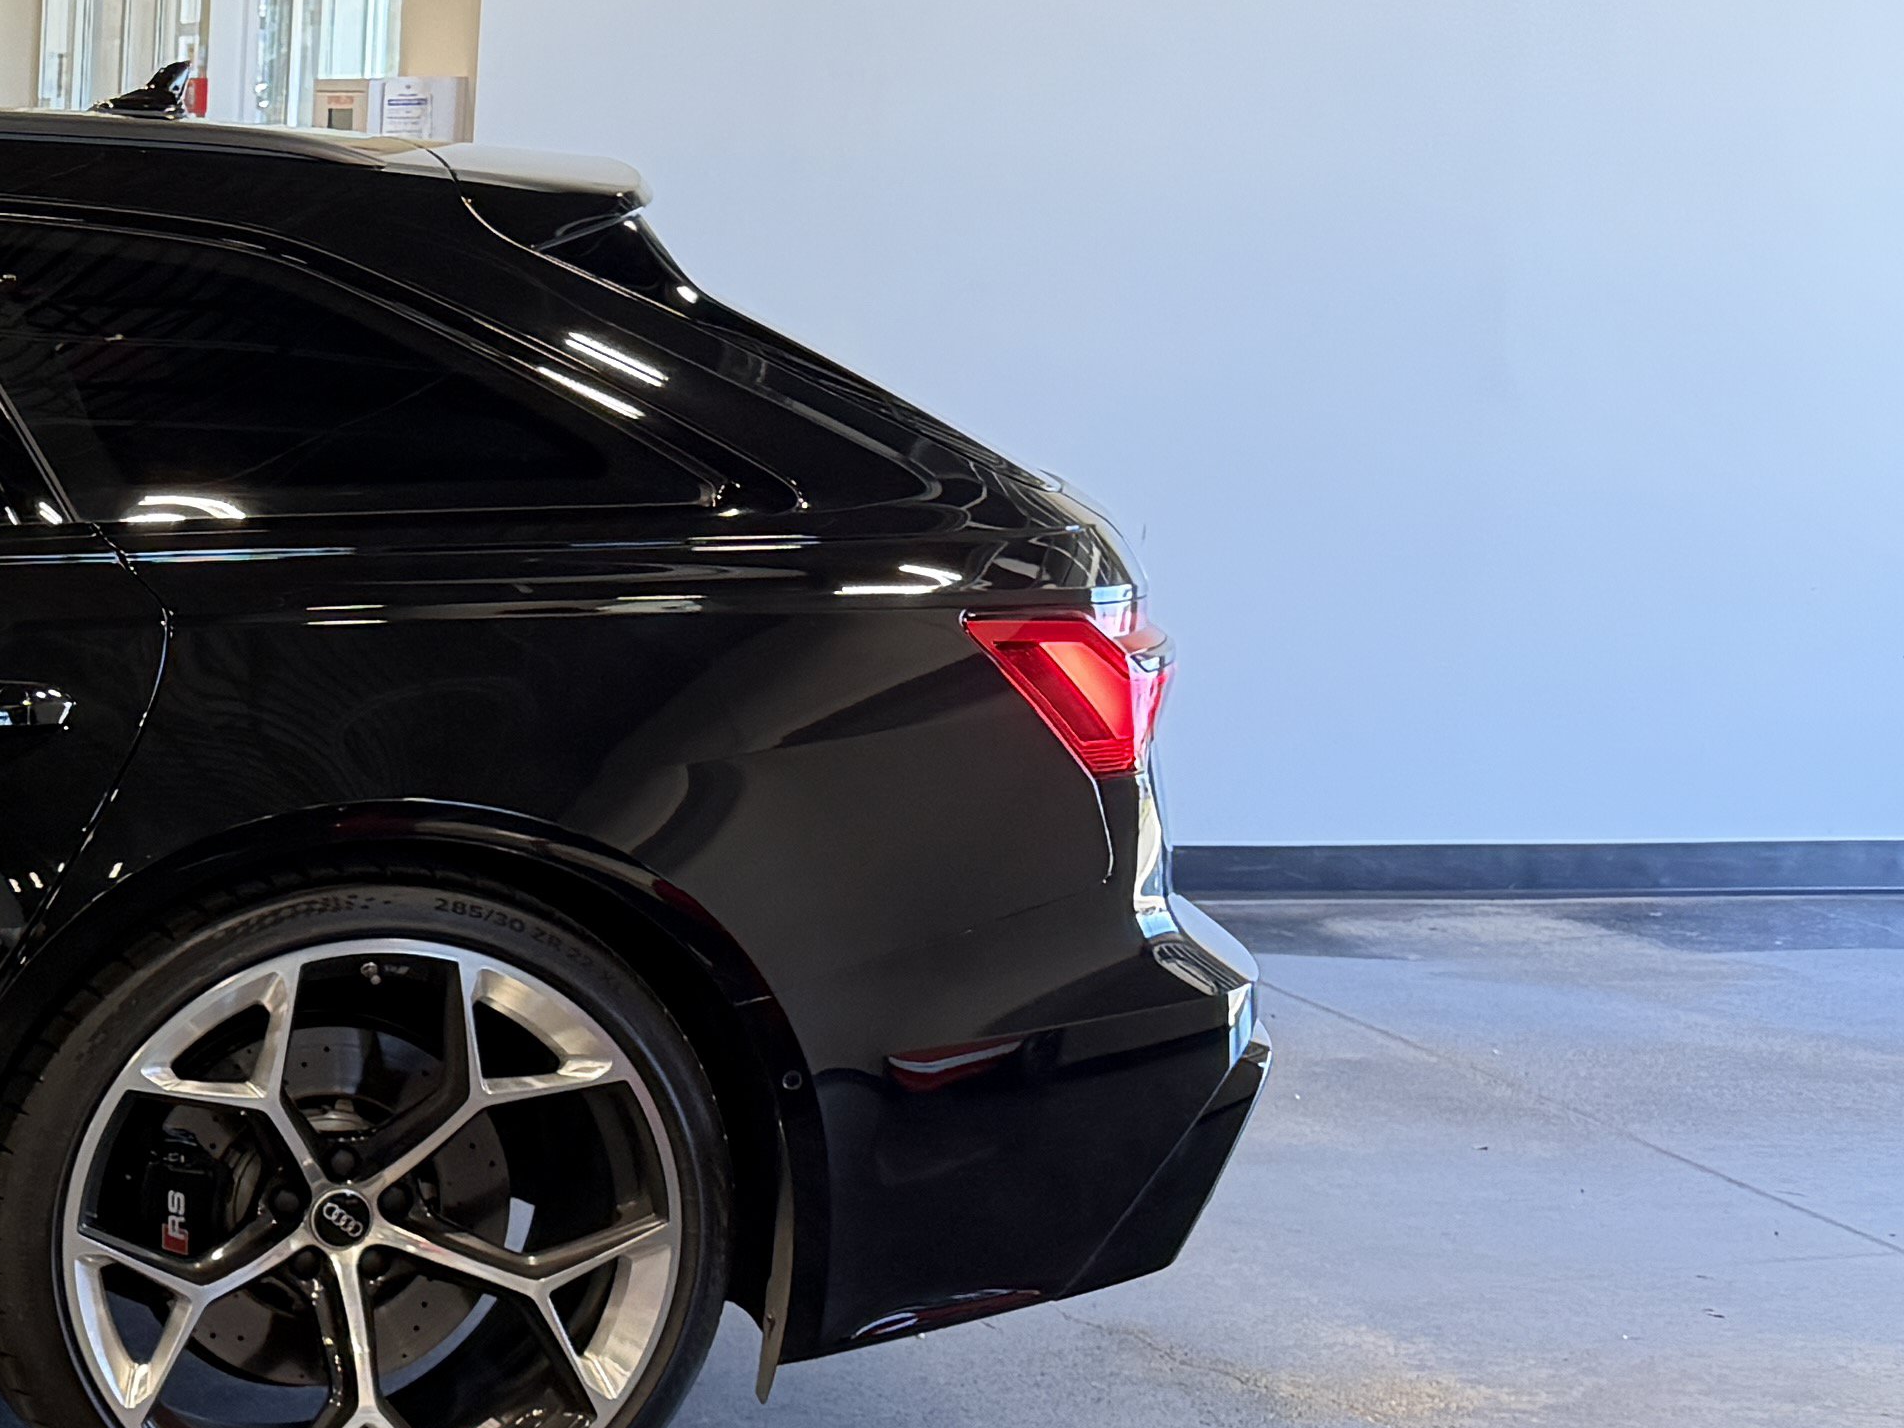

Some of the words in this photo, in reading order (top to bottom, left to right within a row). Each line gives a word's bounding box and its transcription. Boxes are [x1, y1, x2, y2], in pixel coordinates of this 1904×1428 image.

[434, 898, 526, 934] 285/30
[530, 926, 563, 953] ZR
[167, 1189, 186, 1241] RS
